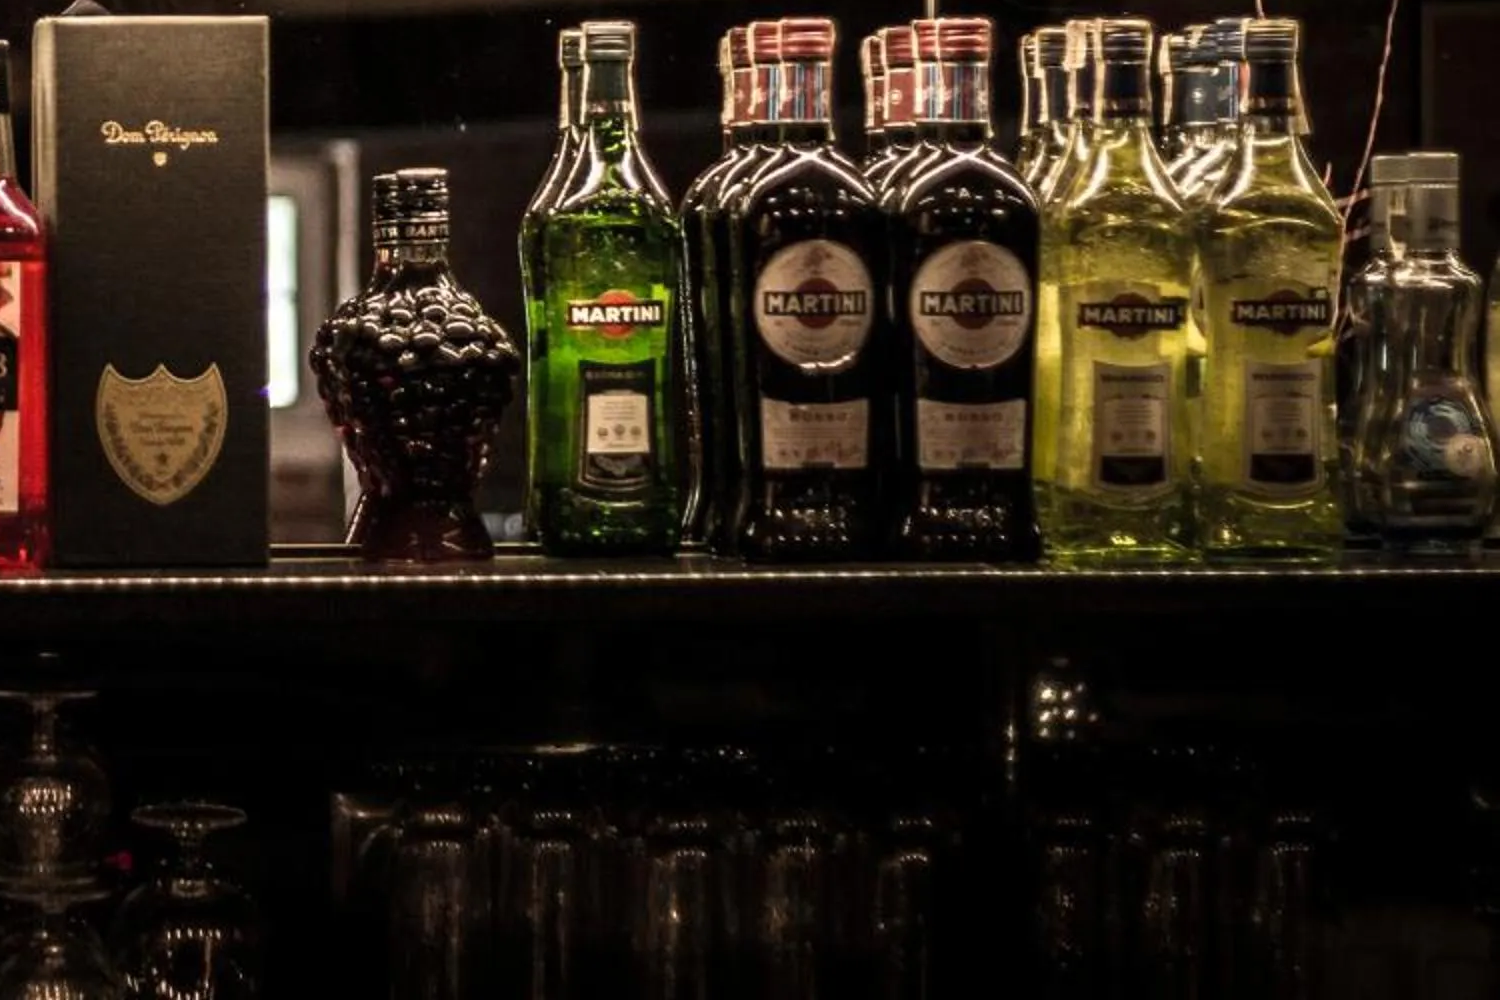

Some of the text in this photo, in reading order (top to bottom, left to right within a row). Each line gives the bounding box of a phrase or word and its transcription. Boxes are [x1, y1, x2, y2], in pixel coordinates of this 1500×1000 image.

[100, 120, 146, 144] Dom
[767, 293, 864, 313] MARTINI
[923, 293, 1021, 313] MARTINI
[1236, 302, 1326, 321] MARTINI
[571, 305, 660, 324] MARTINI
[1083, 306, 1174, 324] MARTINI
